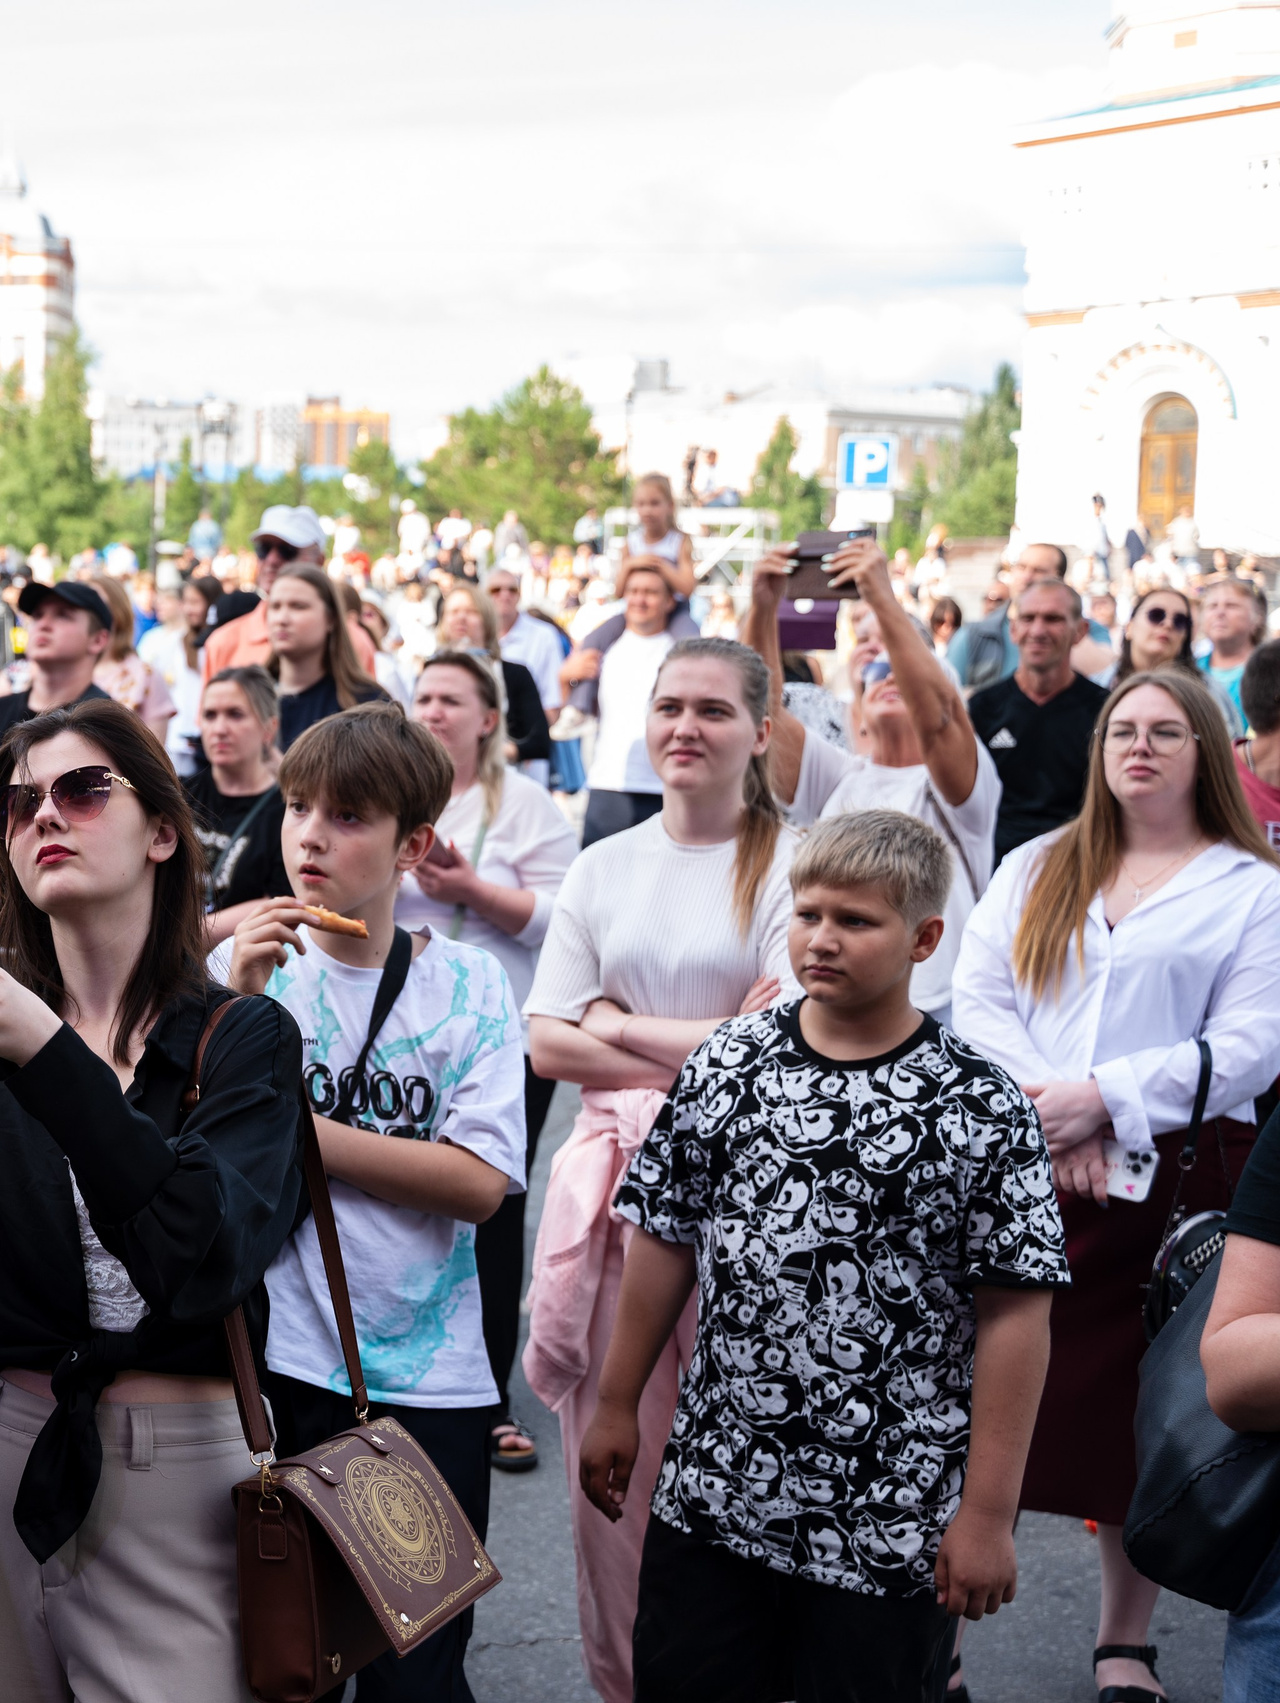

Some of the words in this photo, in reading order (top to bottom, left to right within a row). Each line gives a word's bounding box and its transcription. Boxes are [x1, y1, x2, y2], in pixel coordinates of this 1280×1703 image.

[854, 440, 888, 486] P
[303, 1063, 434, 1123] GOOD
[832, 1170, 886, 1206] vast
[799, 1446, 859, 1475] vast
